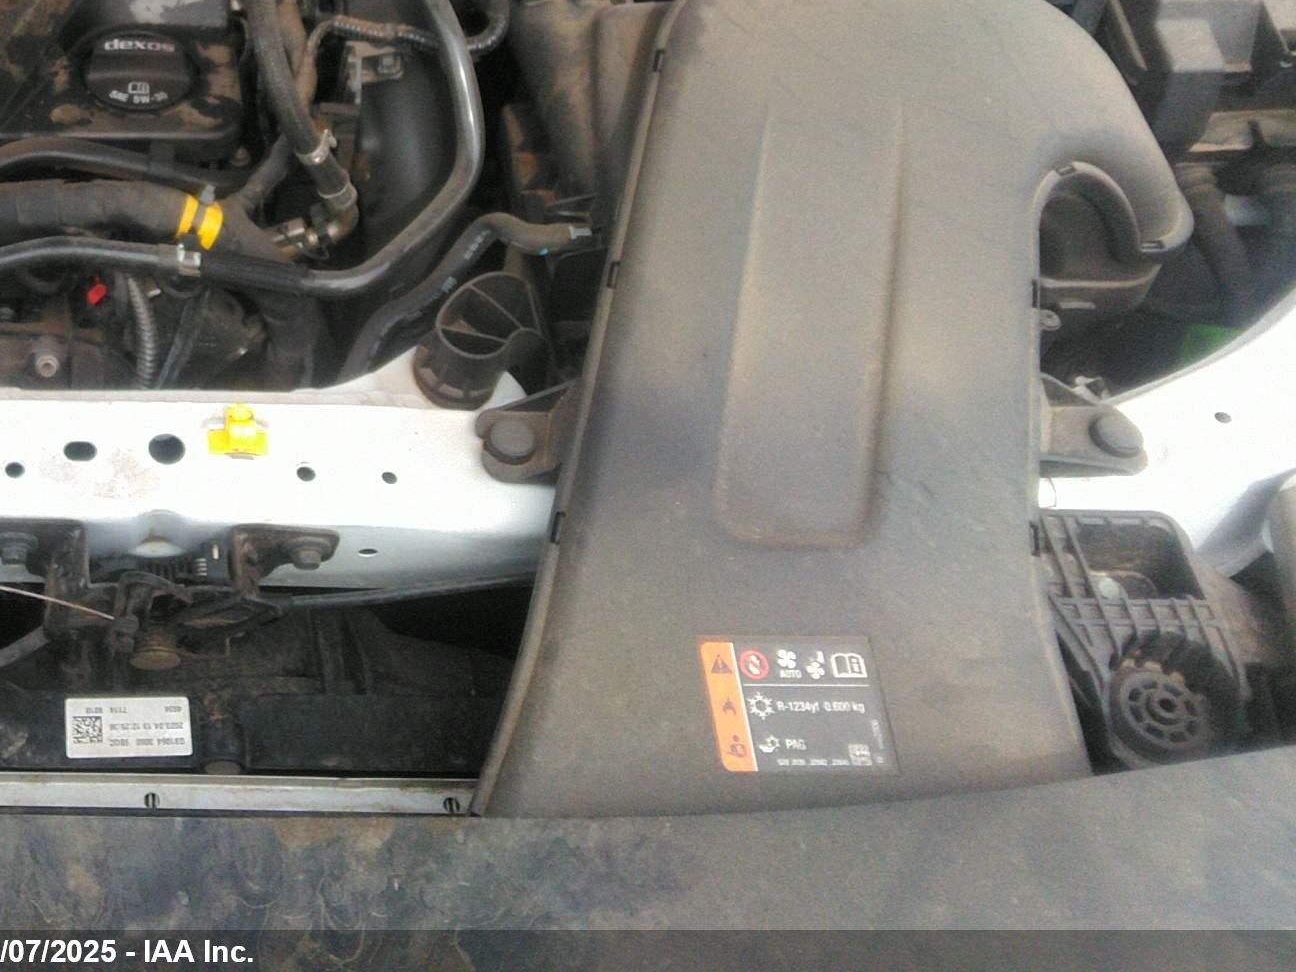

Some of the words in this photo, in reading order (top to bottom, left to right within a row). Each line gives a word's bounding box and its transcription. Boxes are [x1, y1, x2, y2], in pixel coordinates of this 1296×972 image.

[104, 38, 175, 52] dexos
[779, 670, 802, 678] AUTO
[776, 701, 820, 714] R-1234yf
[852, 701, 865, 714] kg
[785, 739, 807, 750] PAG
